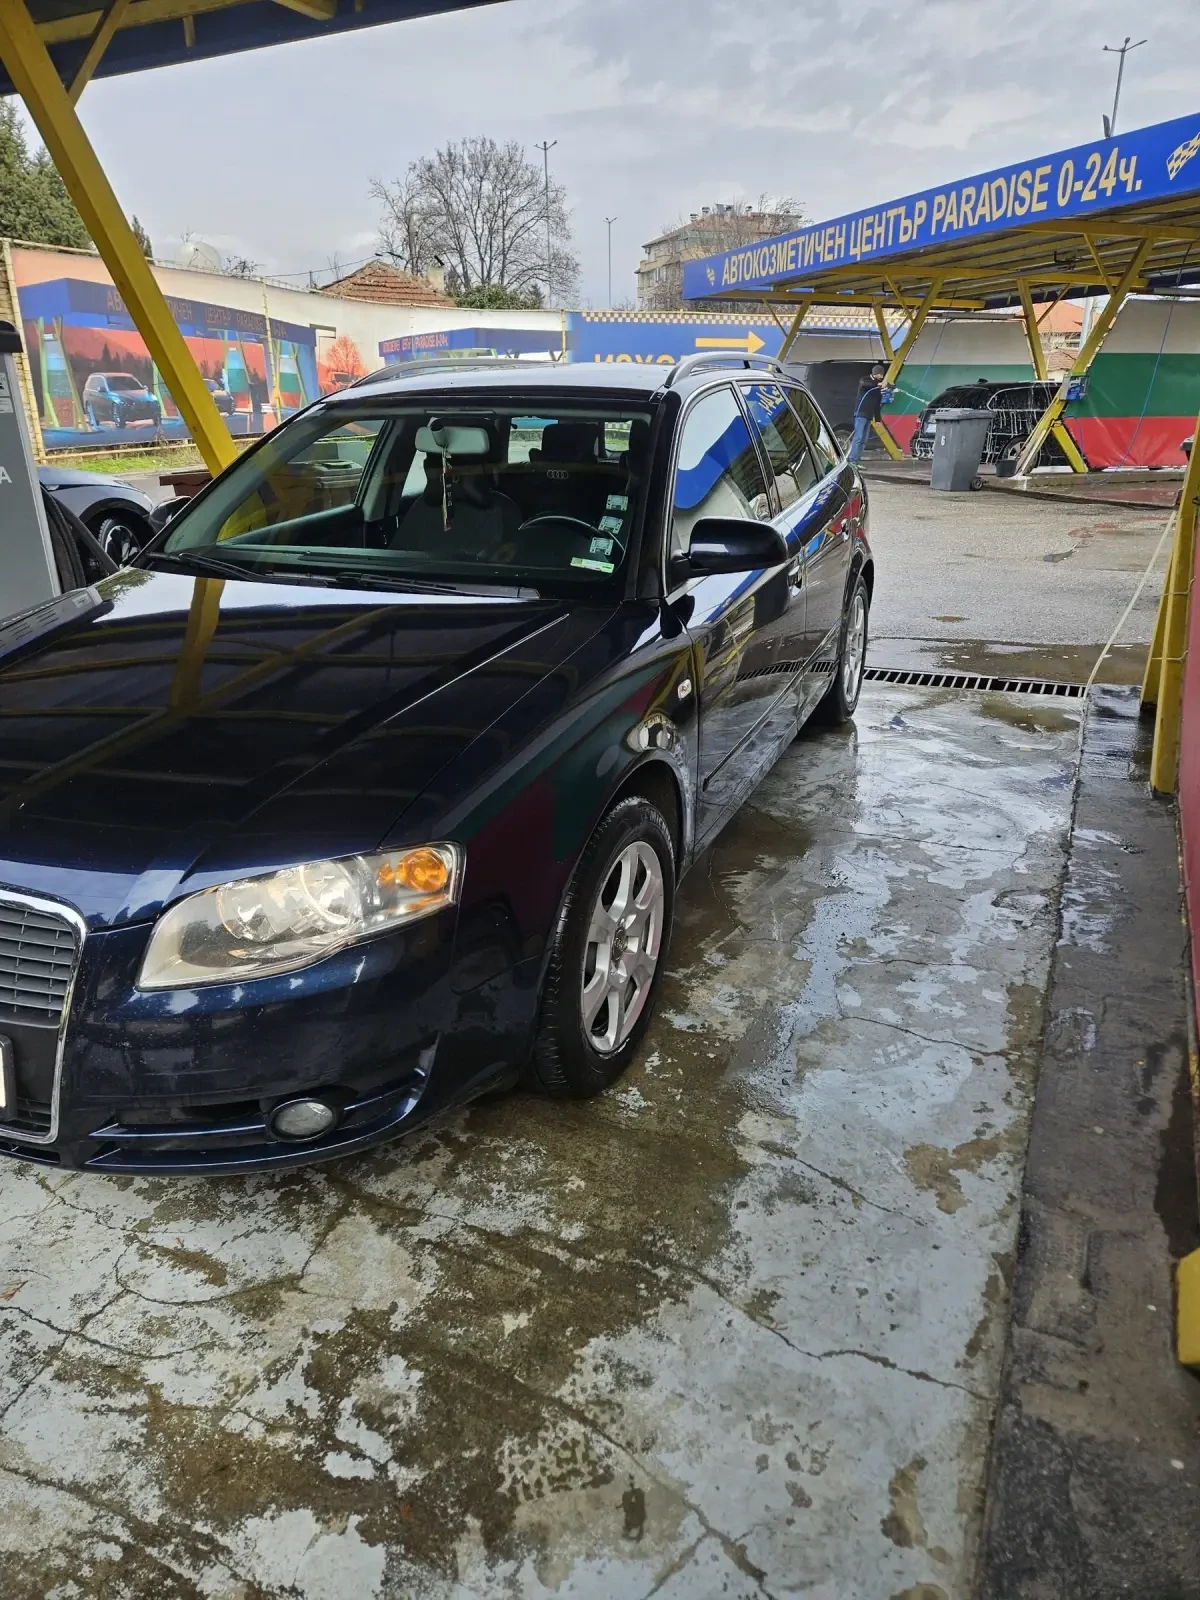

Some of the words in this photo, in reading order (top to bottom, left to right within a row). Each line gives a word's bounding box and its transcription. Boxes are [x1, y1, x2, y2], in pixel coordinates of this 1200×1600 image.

[721, 228, 846, 286] АВТОКОЗМЕТИЧЕН
[849, 203, 927, 257] ЦЕНТЪР
[931, 164, 1052, 233] PARADISE
[1057, 147, 1143, 207] 0-24ч.
